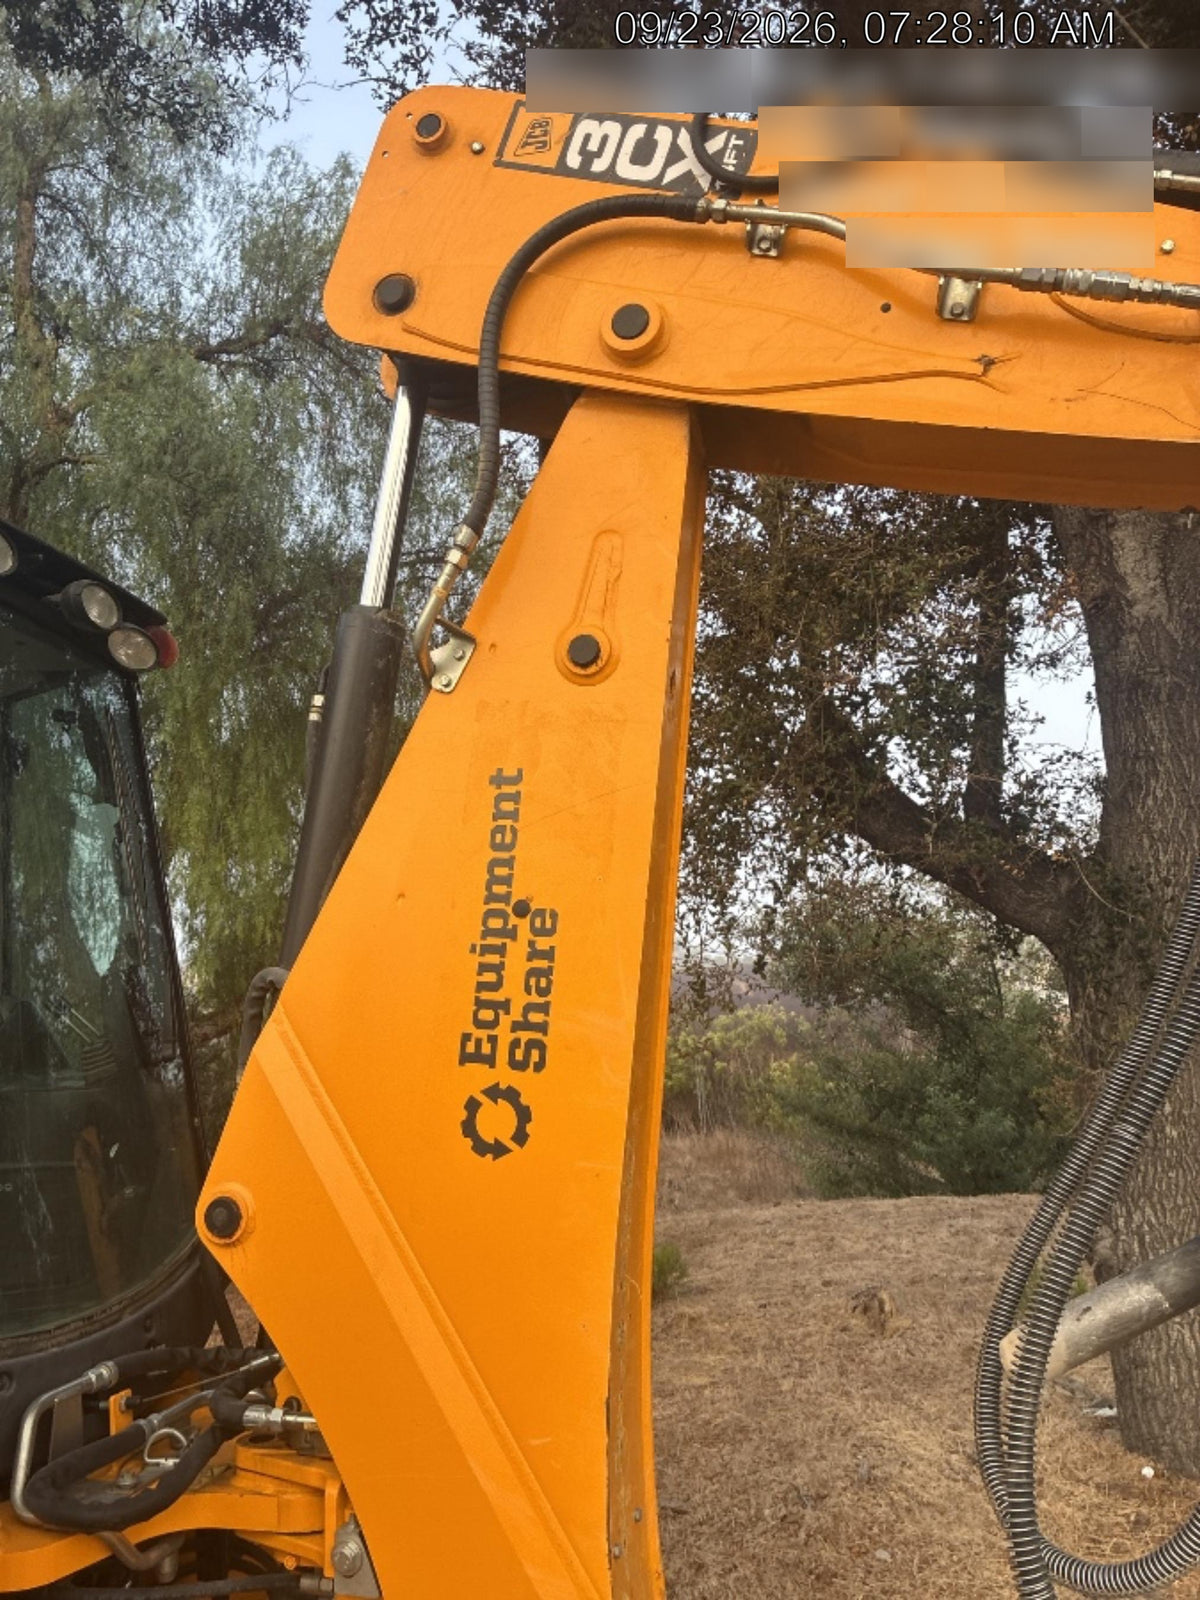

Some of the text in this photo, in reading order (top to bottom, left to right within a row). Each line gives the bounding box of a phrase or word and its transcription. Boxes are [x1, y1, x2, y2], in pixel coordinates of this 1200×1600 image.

[520, 118, 551, 151] JCB
[565, 118, 730, 192] 3CX
[458, 767, 524, 1070] Equipment
[507, 907, 560, 1075] Share
